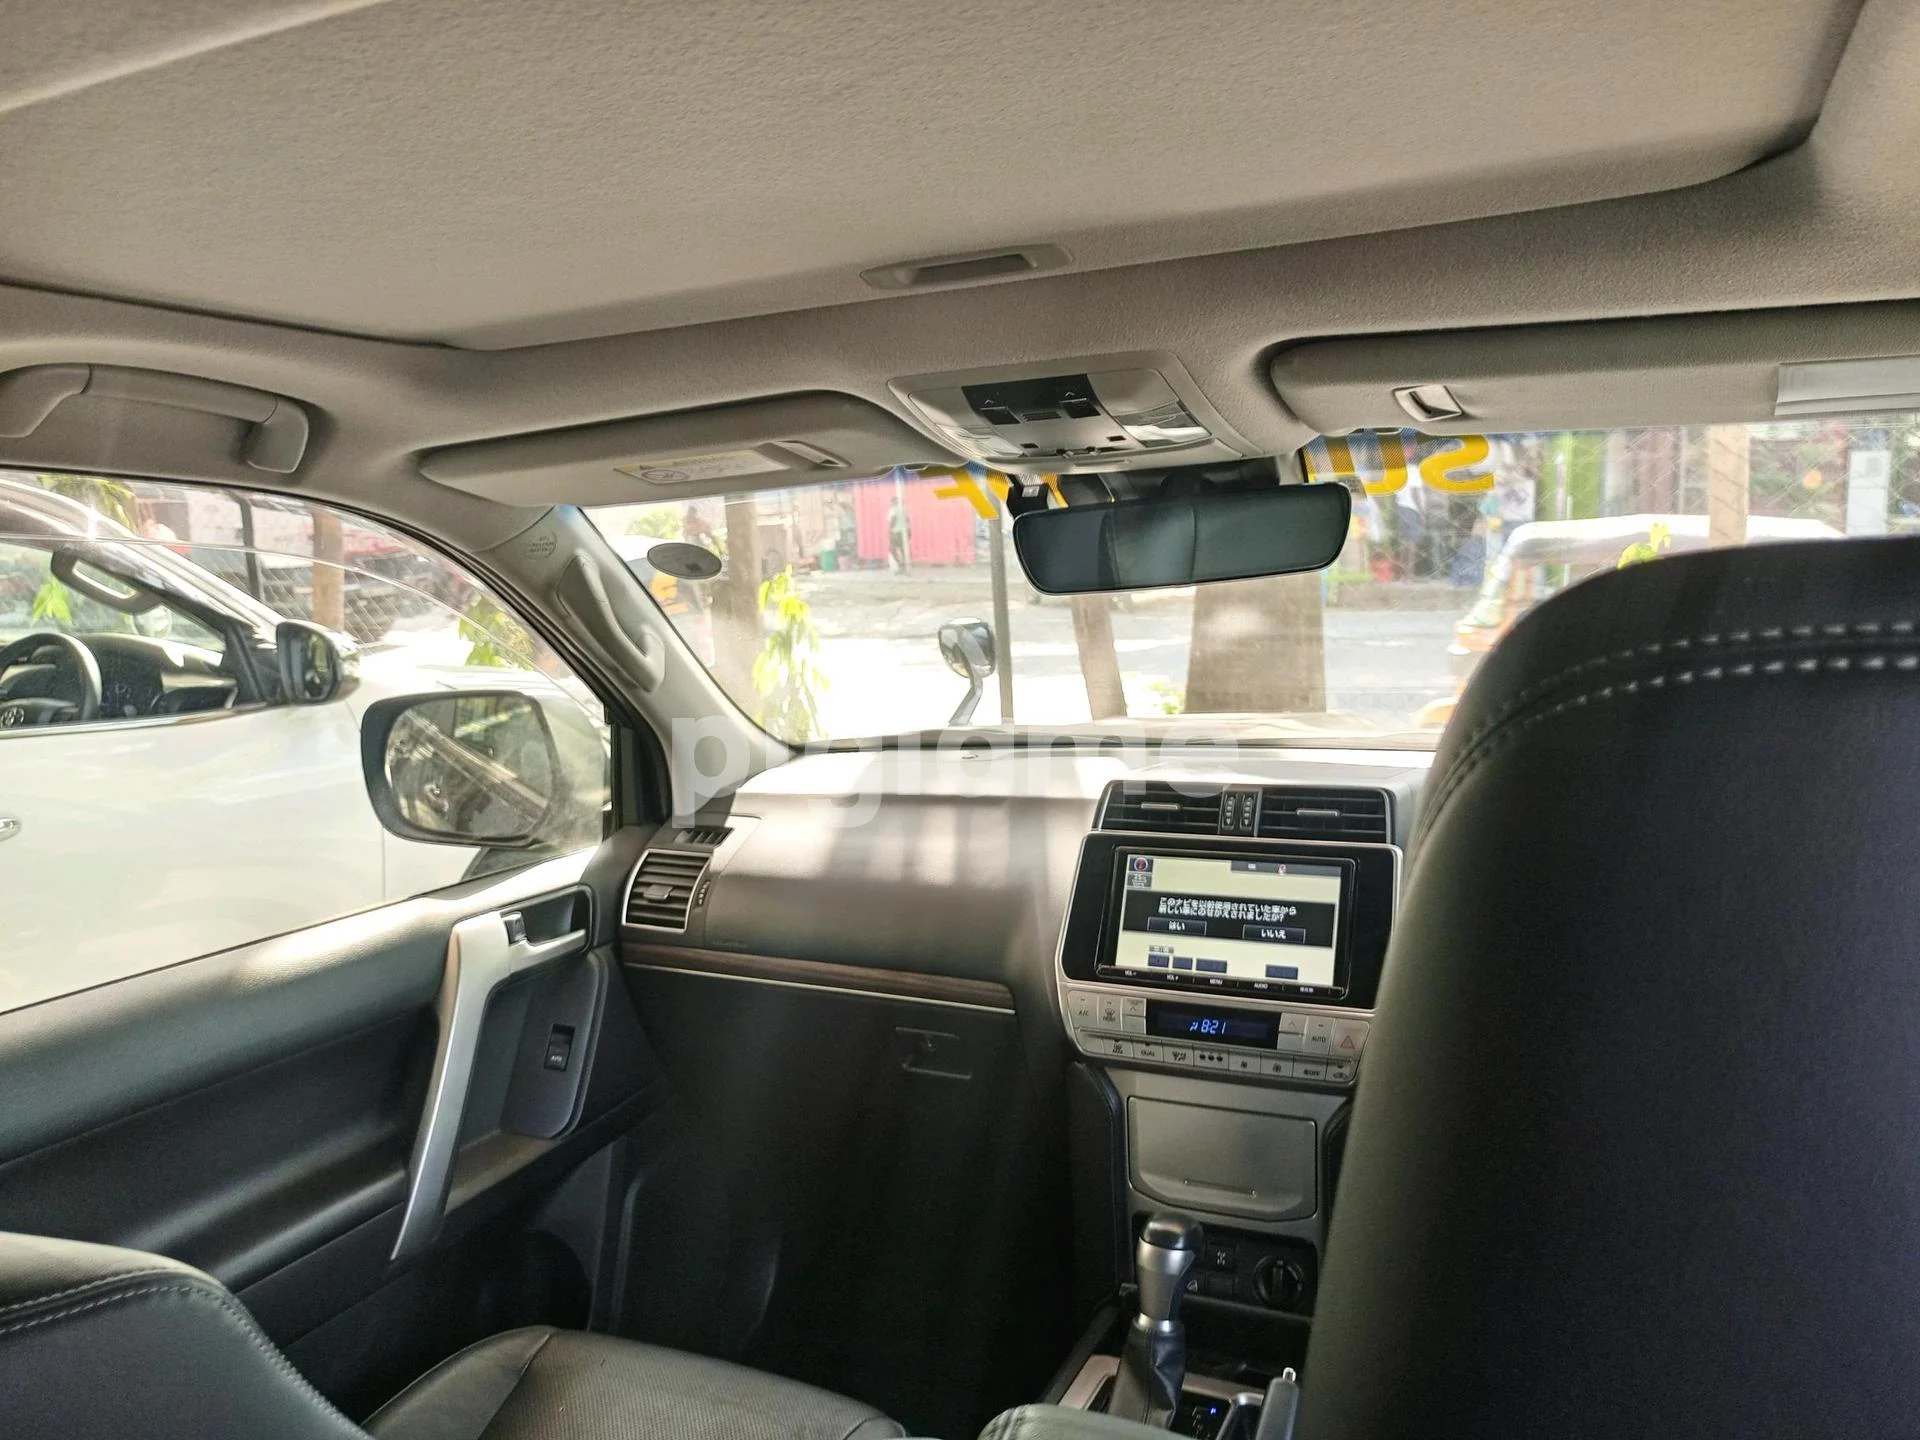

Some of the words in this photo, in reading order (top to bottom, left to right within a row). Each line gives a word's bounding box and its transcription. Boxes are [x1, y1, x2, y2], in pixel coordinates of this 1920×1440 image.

[1261, 928, 1287, 939] いいえ
[1311, 1035, 1327, 1044] AUTO
